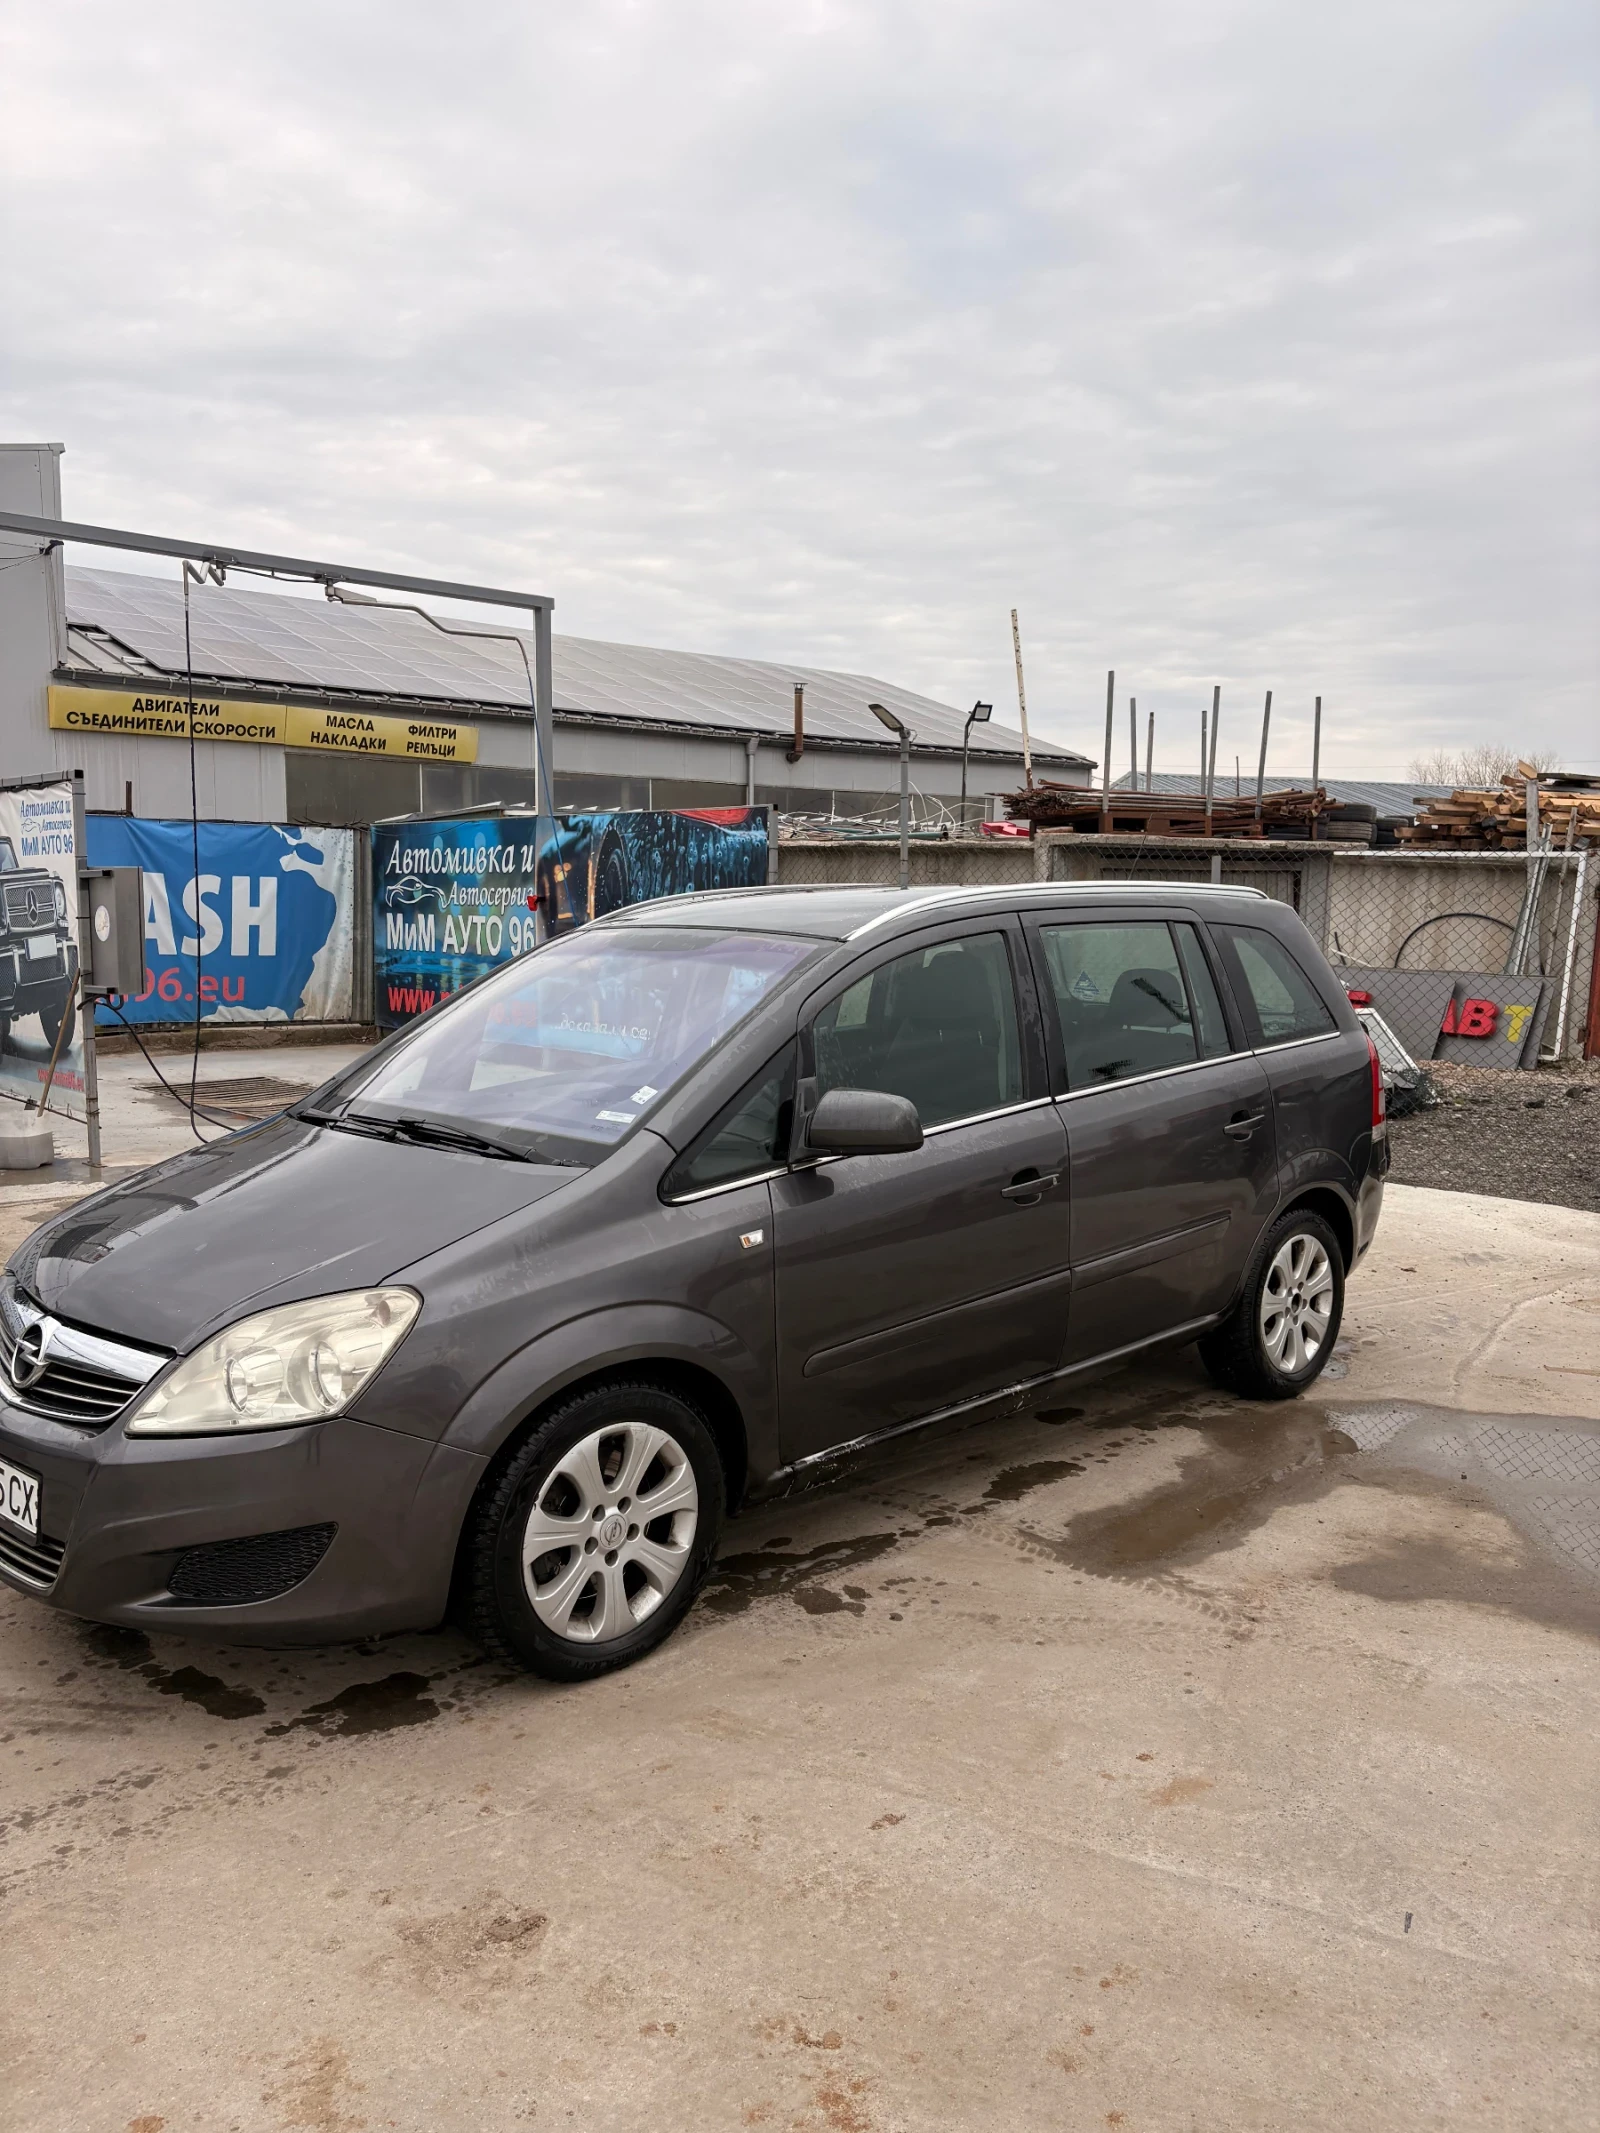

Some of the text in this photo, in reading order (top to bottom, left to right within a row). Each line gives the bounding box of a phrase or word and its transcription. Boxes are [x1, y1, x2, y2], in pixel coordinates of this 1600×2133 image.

[132, 697, 220, 717] ДВИГАТЕЛИ
[66, 711, 276, 739] СЪЕДИНИТЕЛИ СКОРОСТИ
[326, 715, 374, 732] МАСЛА
[408, 724, 457, 740] ФИЛТРИ
[310, 731, 387, 751] НАКЛАДКИ
[406, 741, 456, 757] РЕМЪЦИ
[42, 834, 62, 856] АУТО
[63, 834, 73, 854] 96
[385, 840, 534, 874] Автомивка и
[386, 912, 535, 957] МиМ АУТО 96
